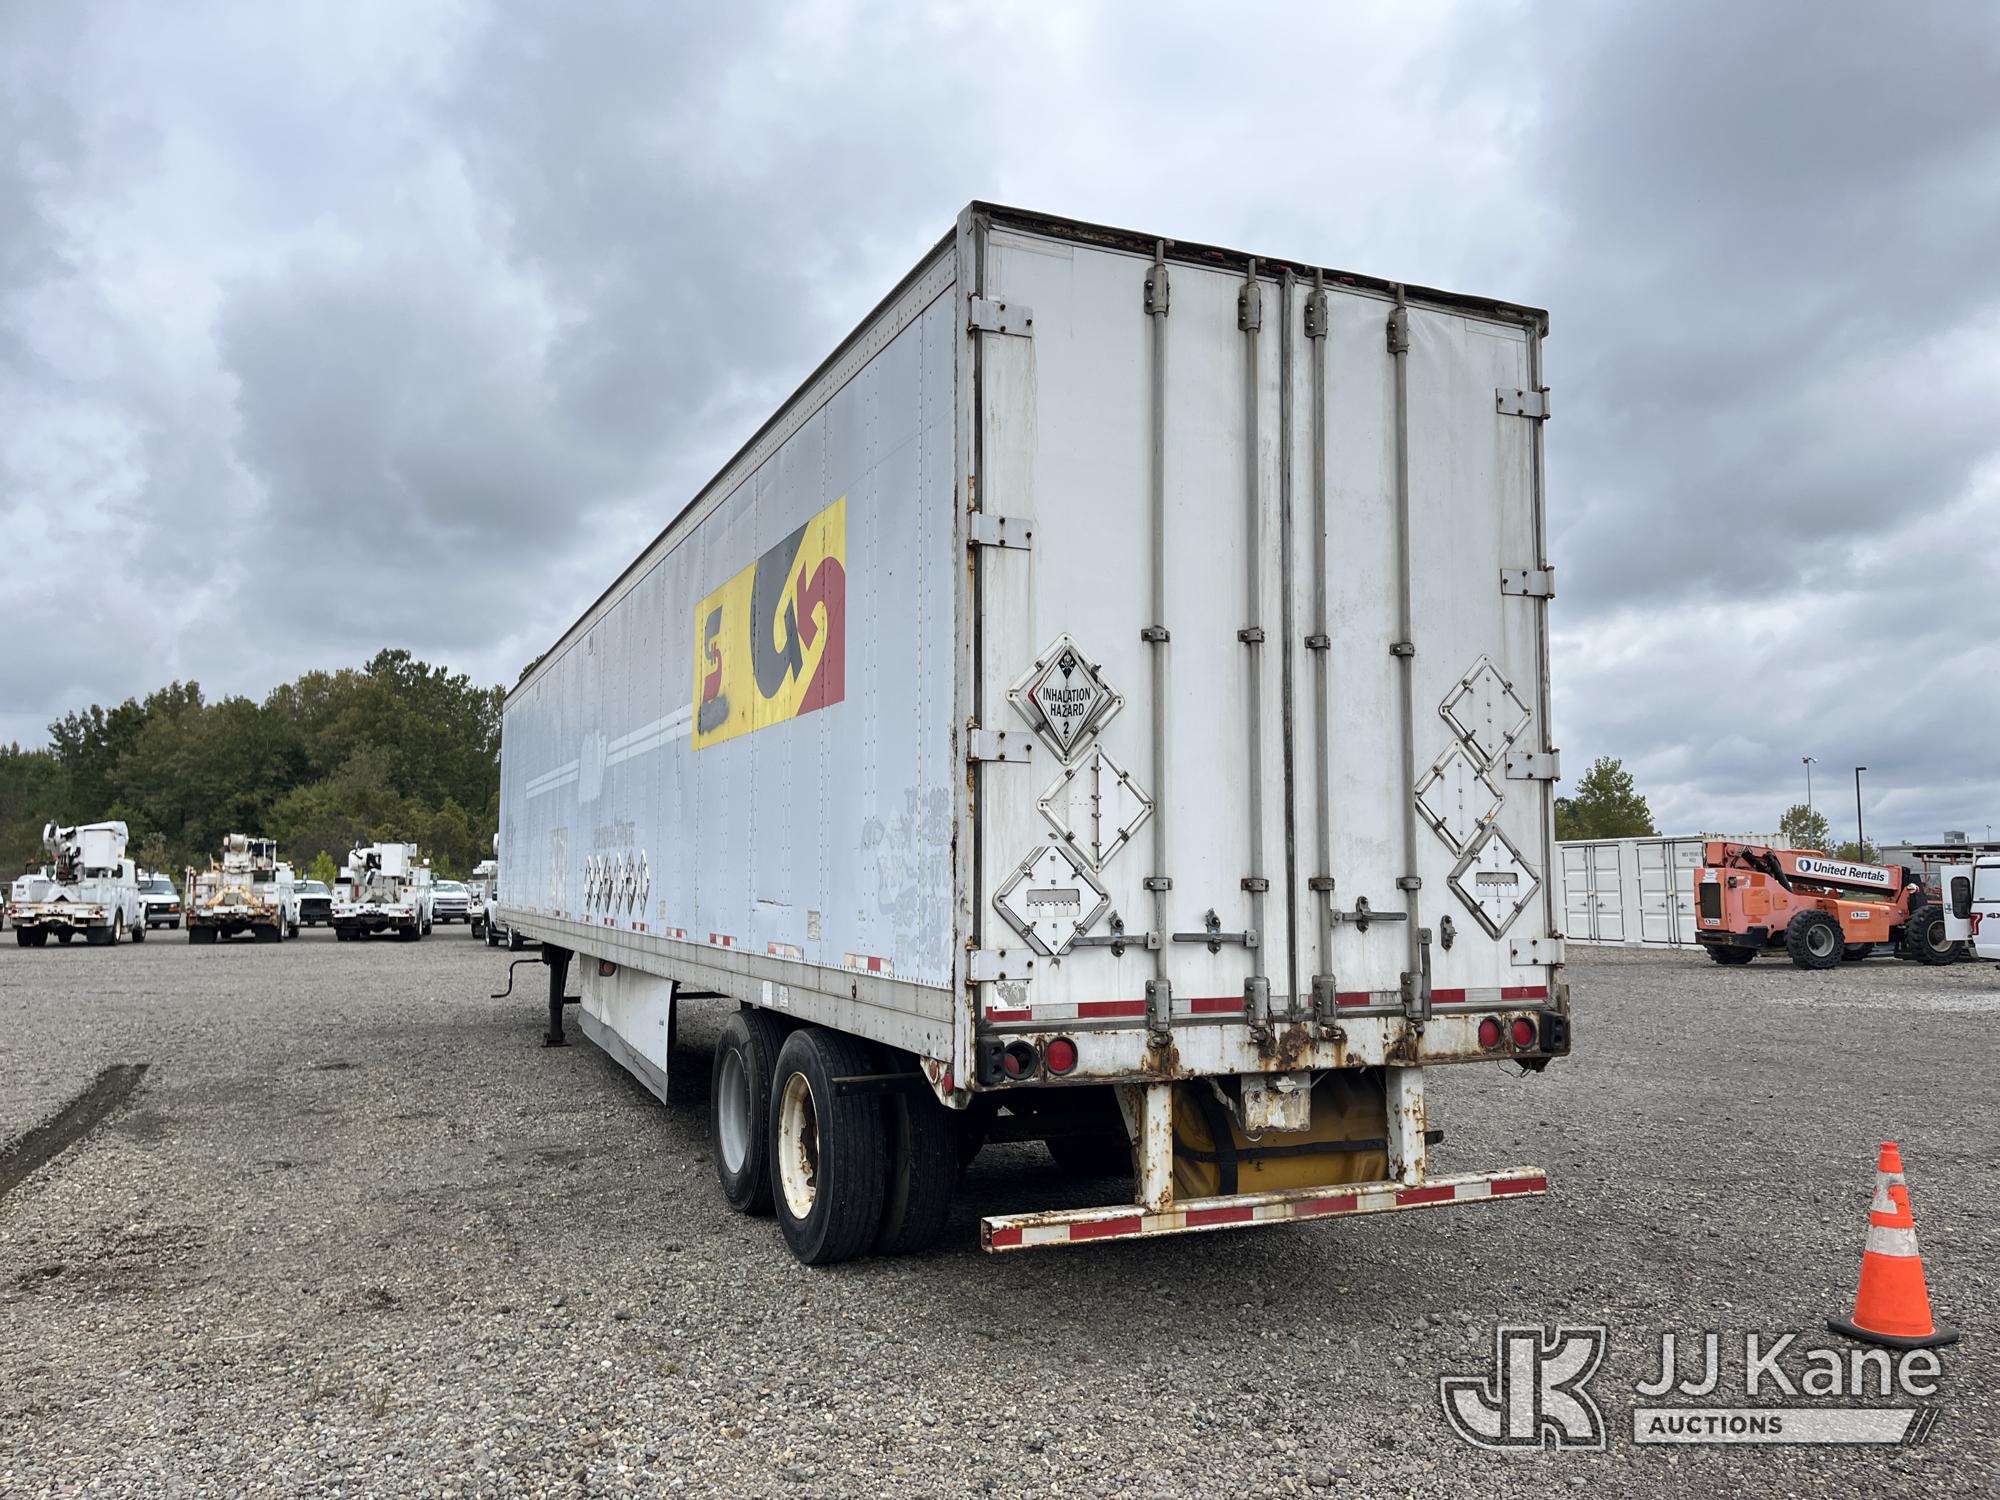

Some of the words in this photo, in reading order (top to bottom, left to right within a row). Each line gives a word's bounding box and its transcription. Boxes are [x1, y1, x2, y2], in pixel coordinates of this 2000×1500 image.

[1043, 687, 1091, 703] INHALATION
[1050, 703, 1085, 717] HAZARD
[1063, 721, 1070, 735] 2
[1813, 862, 1846, 876] United
[1848, 867, 1885, 882] Rentals
